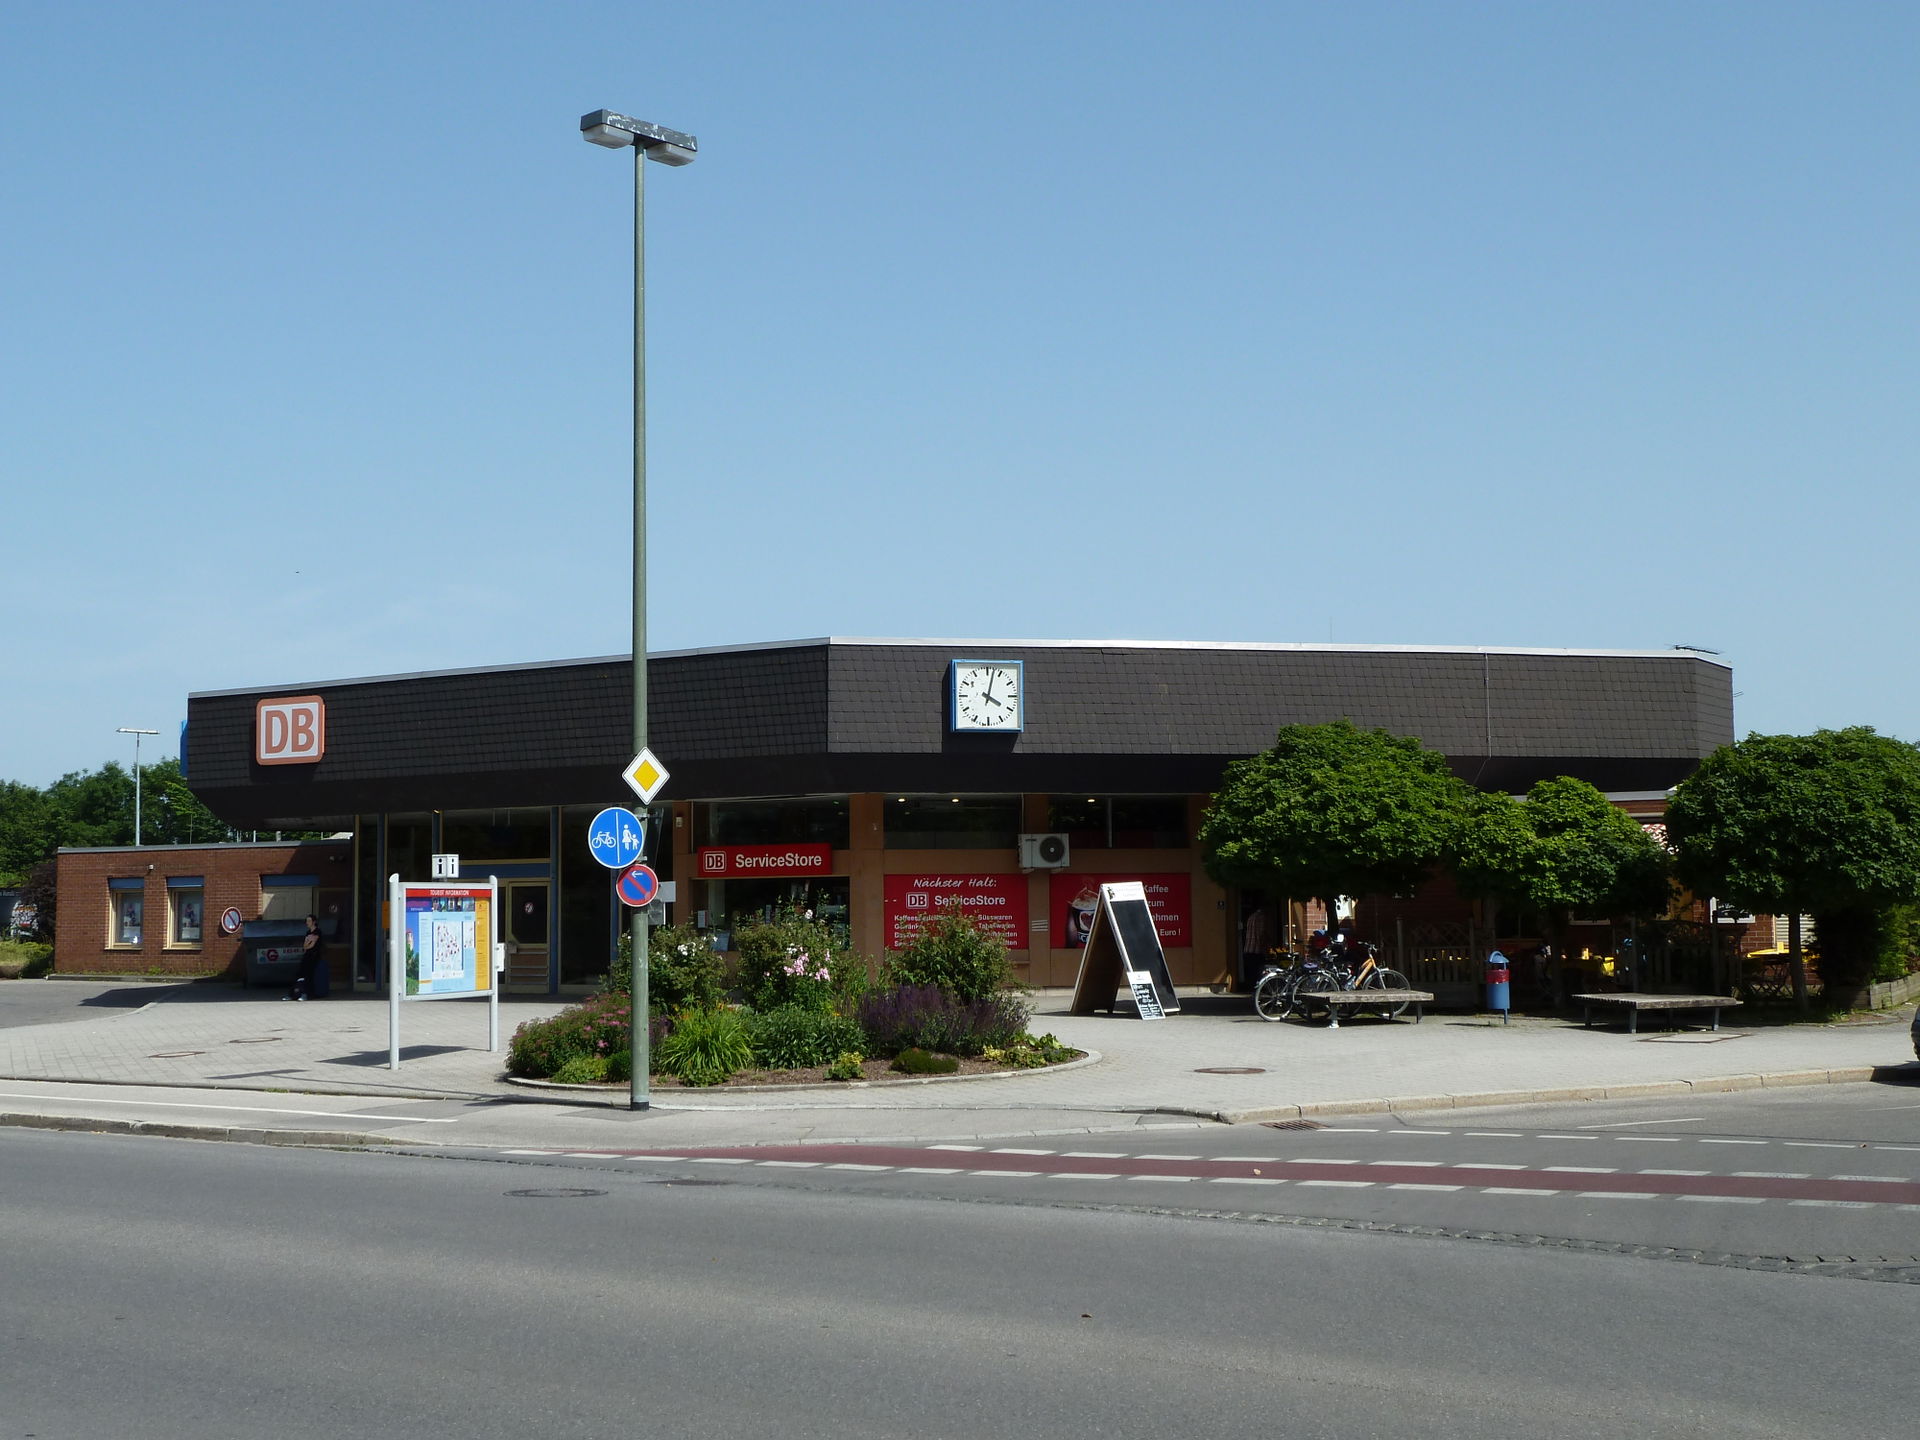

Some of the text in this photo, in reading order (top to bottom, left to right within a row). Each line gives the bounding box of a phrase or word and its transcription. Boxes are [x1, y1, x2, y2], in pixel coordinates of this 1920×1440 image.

[263, 706, 316, 756] DB
[706, 852, 822, 869] DB ServiceStore
[913, 876, 997, 888] Nächster Halt:
[908, 895, 1006, 907] DB ServiceStore
[1160, 928, 1177, 936] Euro
